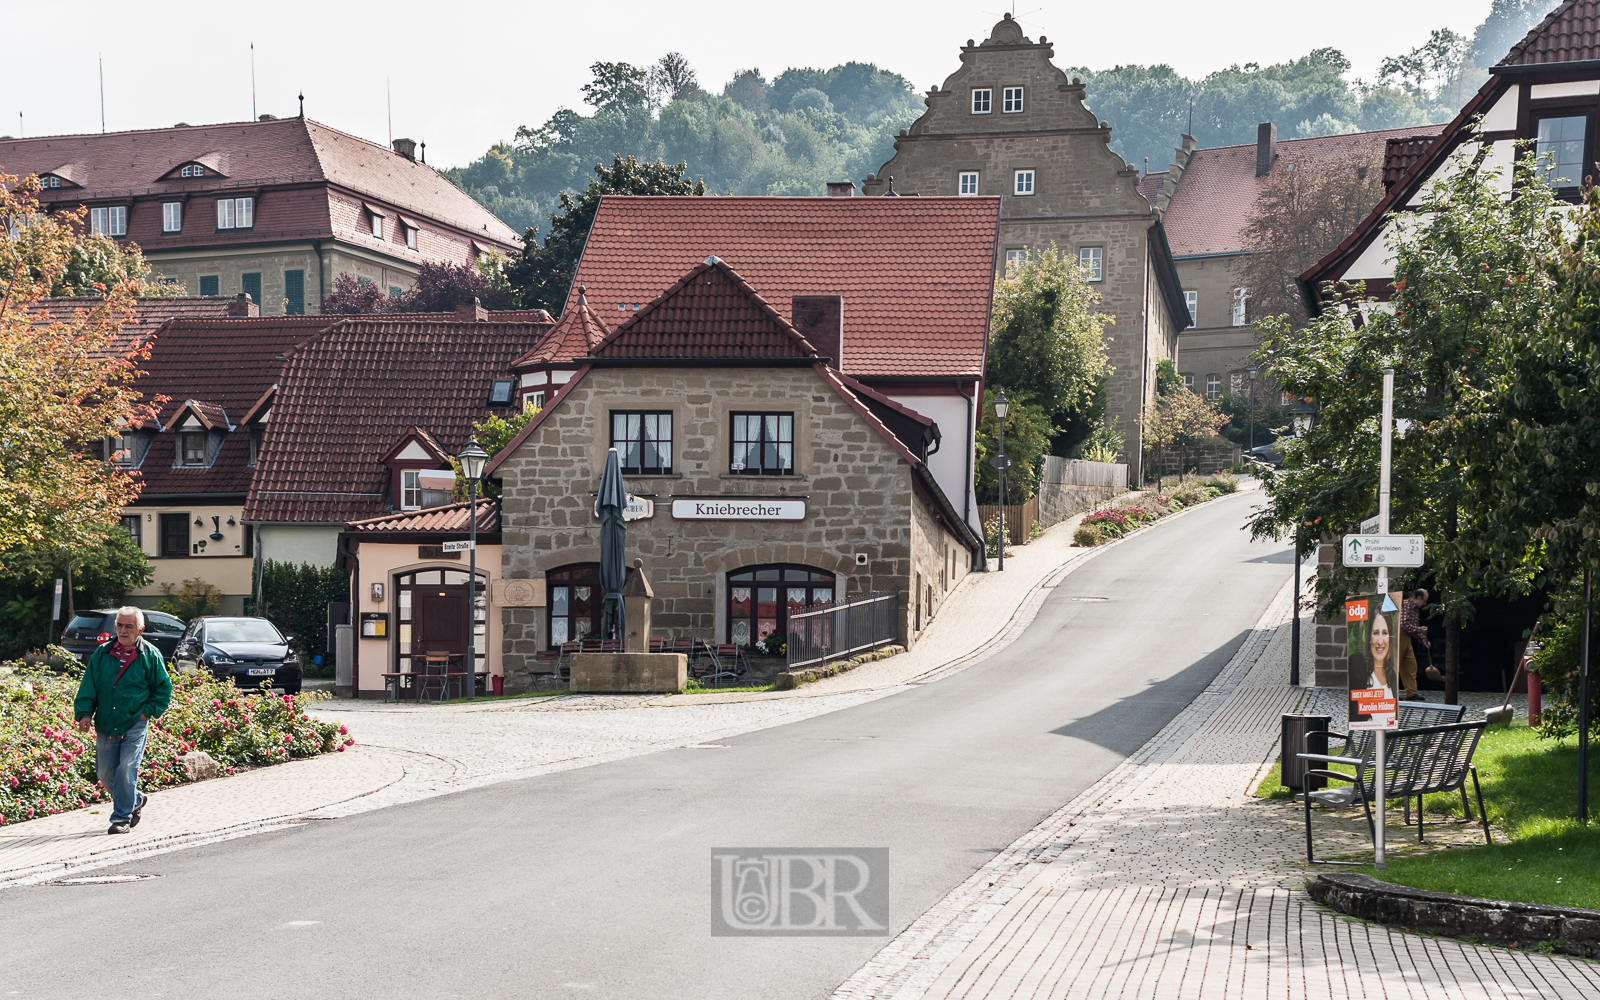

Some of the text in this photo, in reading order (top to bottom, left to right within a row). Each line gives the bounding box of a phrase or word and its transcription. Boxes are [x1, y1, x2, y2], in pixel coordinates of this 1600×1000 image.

[695, 503, 782, 516] Kniebrecher
[147, 514, 152, 522] 3
[1349, 604, 1366, 619] ödp
[1359, 702, 1394, 711] Karolin Hildner
